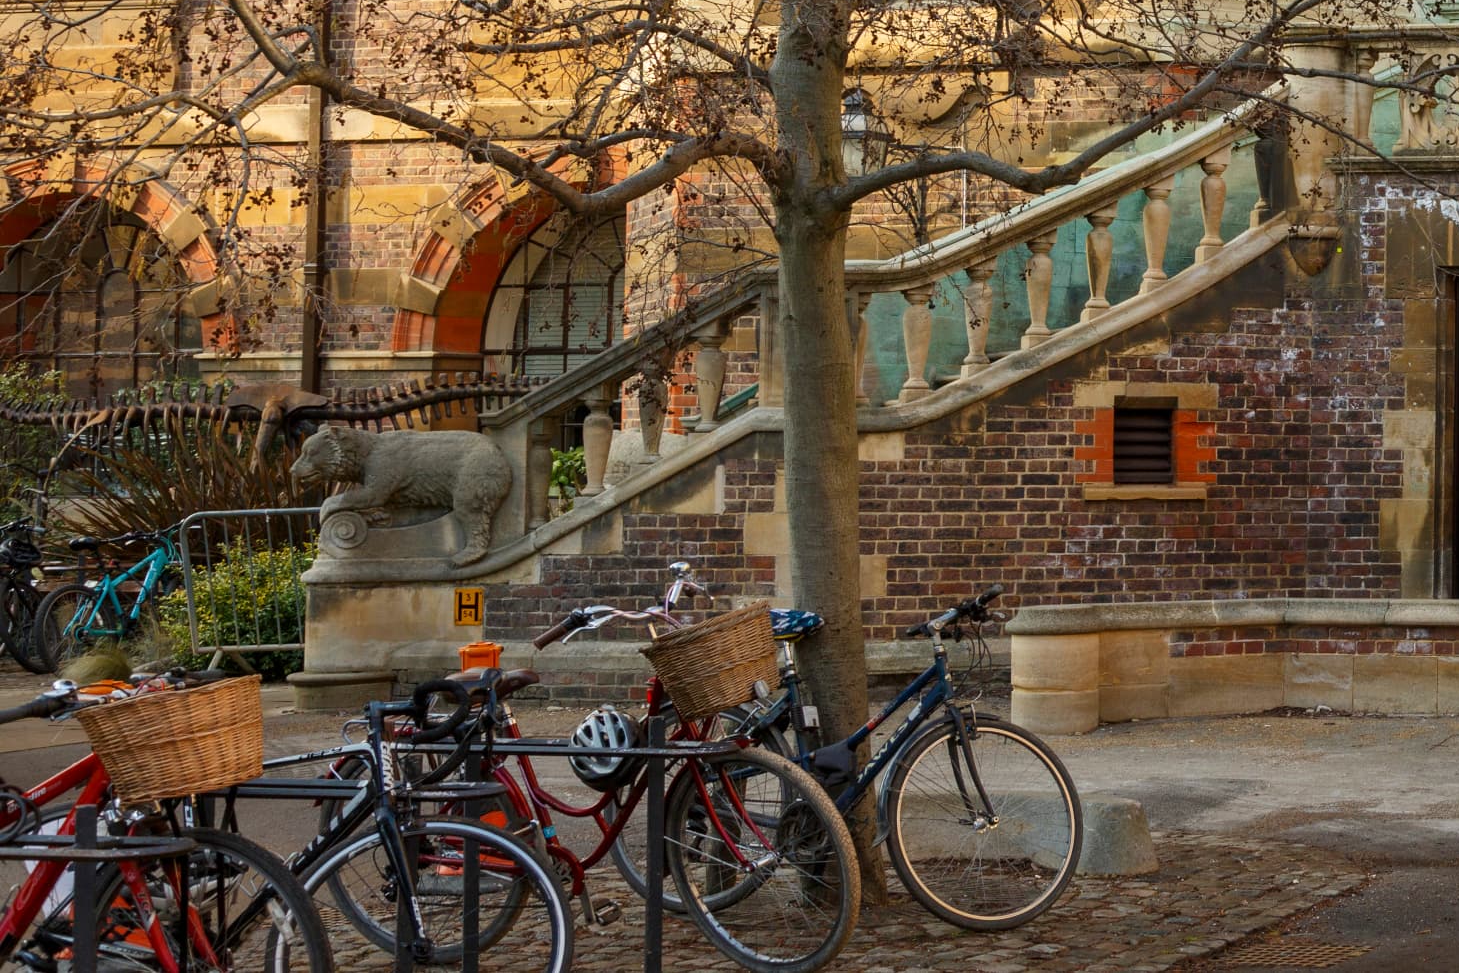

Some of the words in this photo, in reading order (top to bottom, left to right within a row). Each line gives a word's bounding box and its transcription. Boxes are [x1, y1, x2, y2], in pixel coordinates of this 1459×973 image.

[458, 591, 479, 622] H
[463, 610, 473, 618] 54
[380, 740, 396, 794] GIANT
